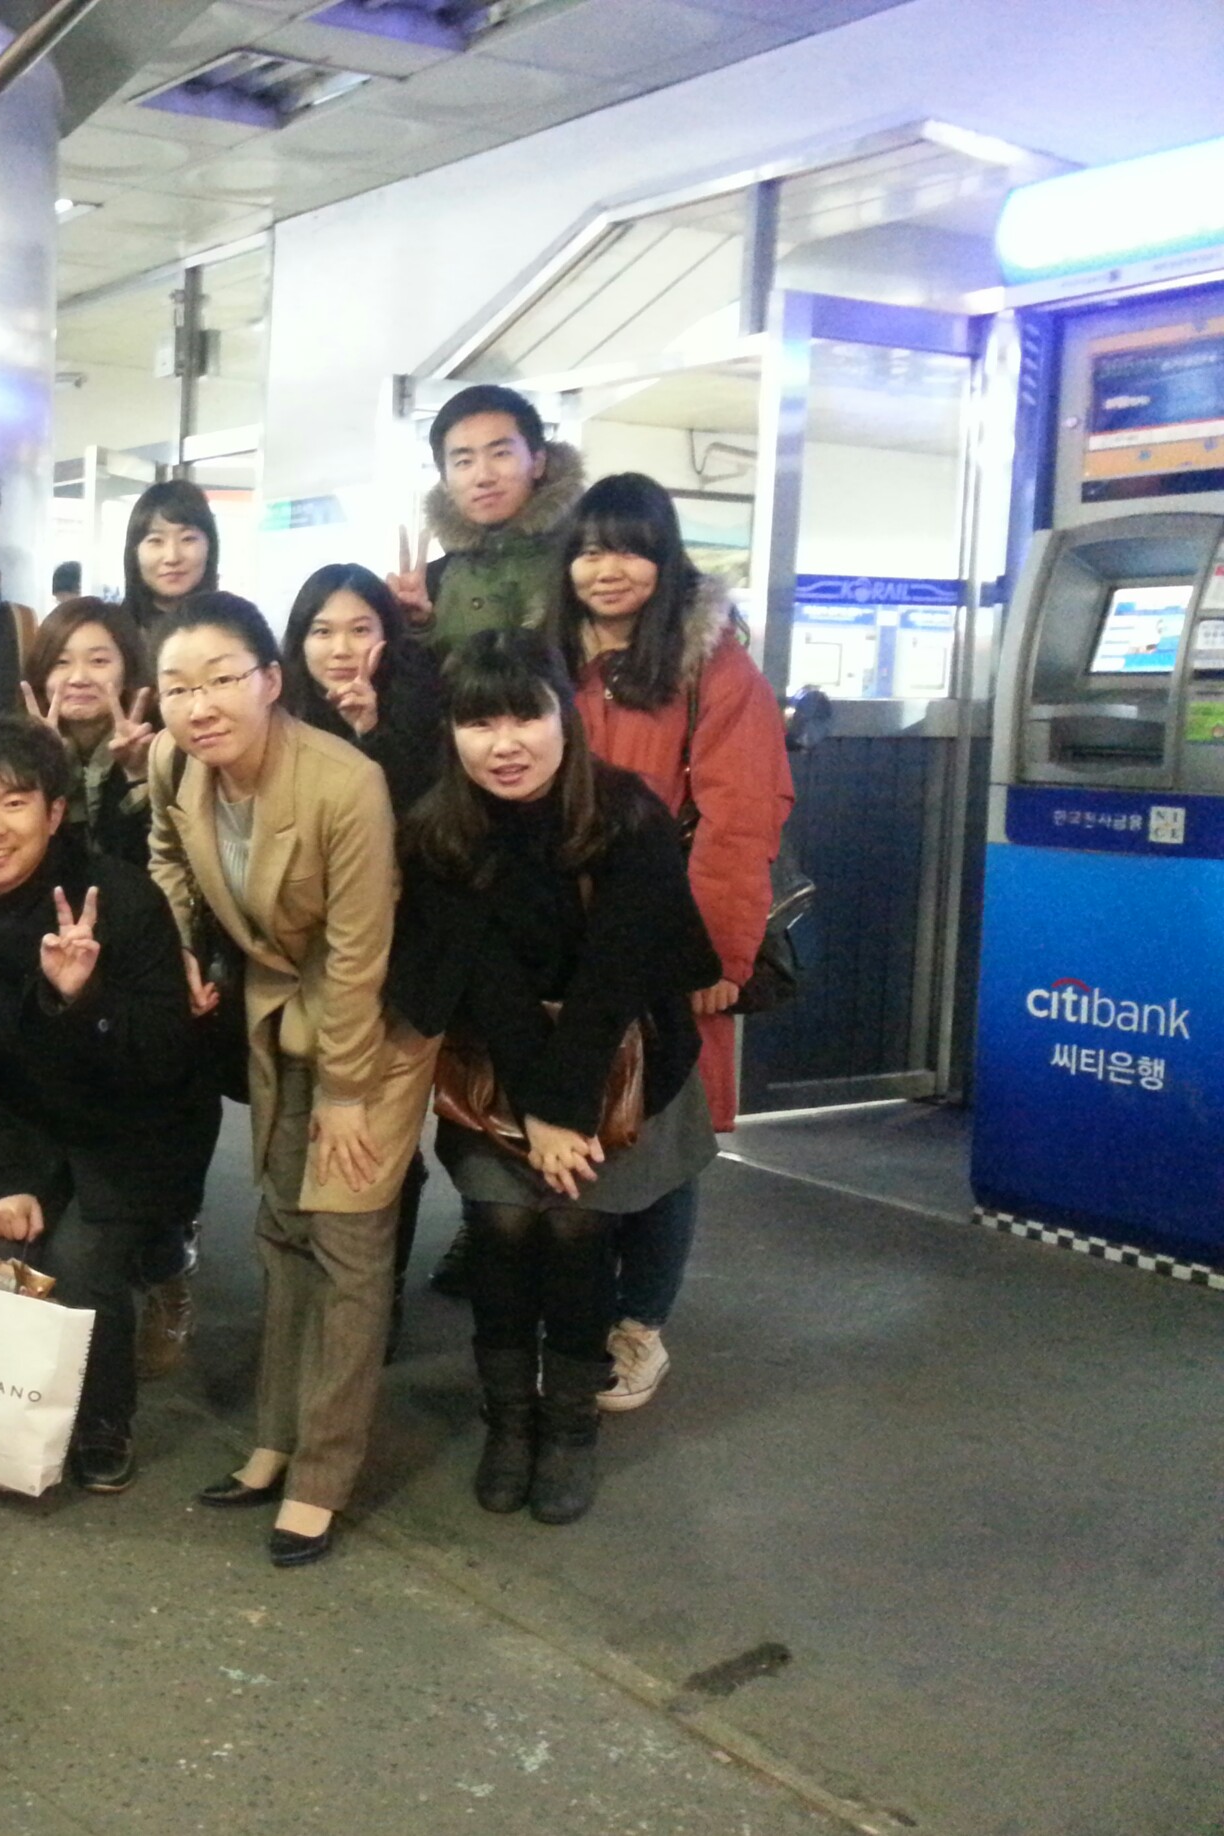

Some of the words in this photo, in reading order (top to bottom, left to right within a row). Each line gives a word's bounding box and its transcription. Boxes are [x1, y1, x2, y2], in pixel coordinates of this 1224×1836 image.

[842, 578, 911, 603] KORAIL
[1026, 986, 1191, 1040] citibank
[1051, 1043, 1166, 1091] 씨티은행
